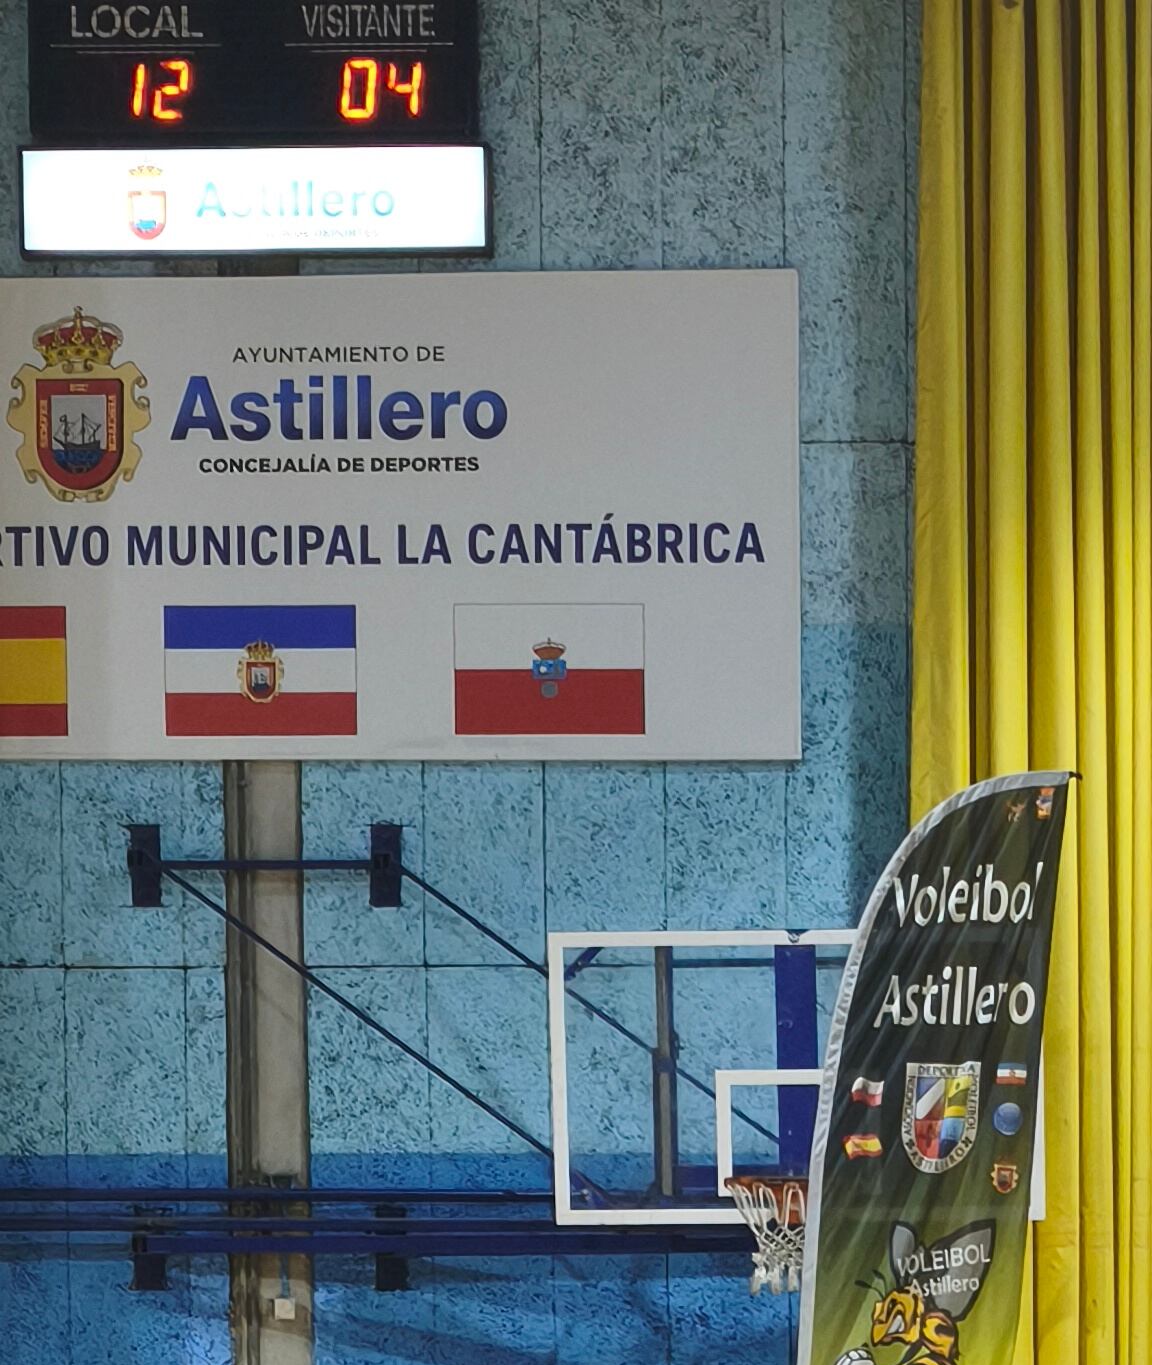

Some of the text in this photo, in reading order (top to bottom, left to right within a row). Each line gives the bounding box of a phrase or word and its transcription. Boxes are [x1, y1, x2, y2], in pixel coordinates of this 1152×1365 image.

[70, 5, 204, 39] LOCAL
[302, 4, 437, 39] VISITANTE
[131, 59, 191, 120] 12
[340, 58, 423, 119] 04
[232, 346, 446, 364] AYUNTAMIENTO DE
[170, 375, 508, 442] Astillero
[199, 454, 480, 473] CONCEJALÍA DE DEPORTES
[0, 513, 765, 567] TIVO MUNICIPAL LA CANTÁBRICA
[893, 861, 1043, 928] Voleibol
[873, 965, 1036, 1029] Astillero
[898, 1244, 990, 1276] VOLEIBOL
[911, 1277, 980, 1299] Astillero
